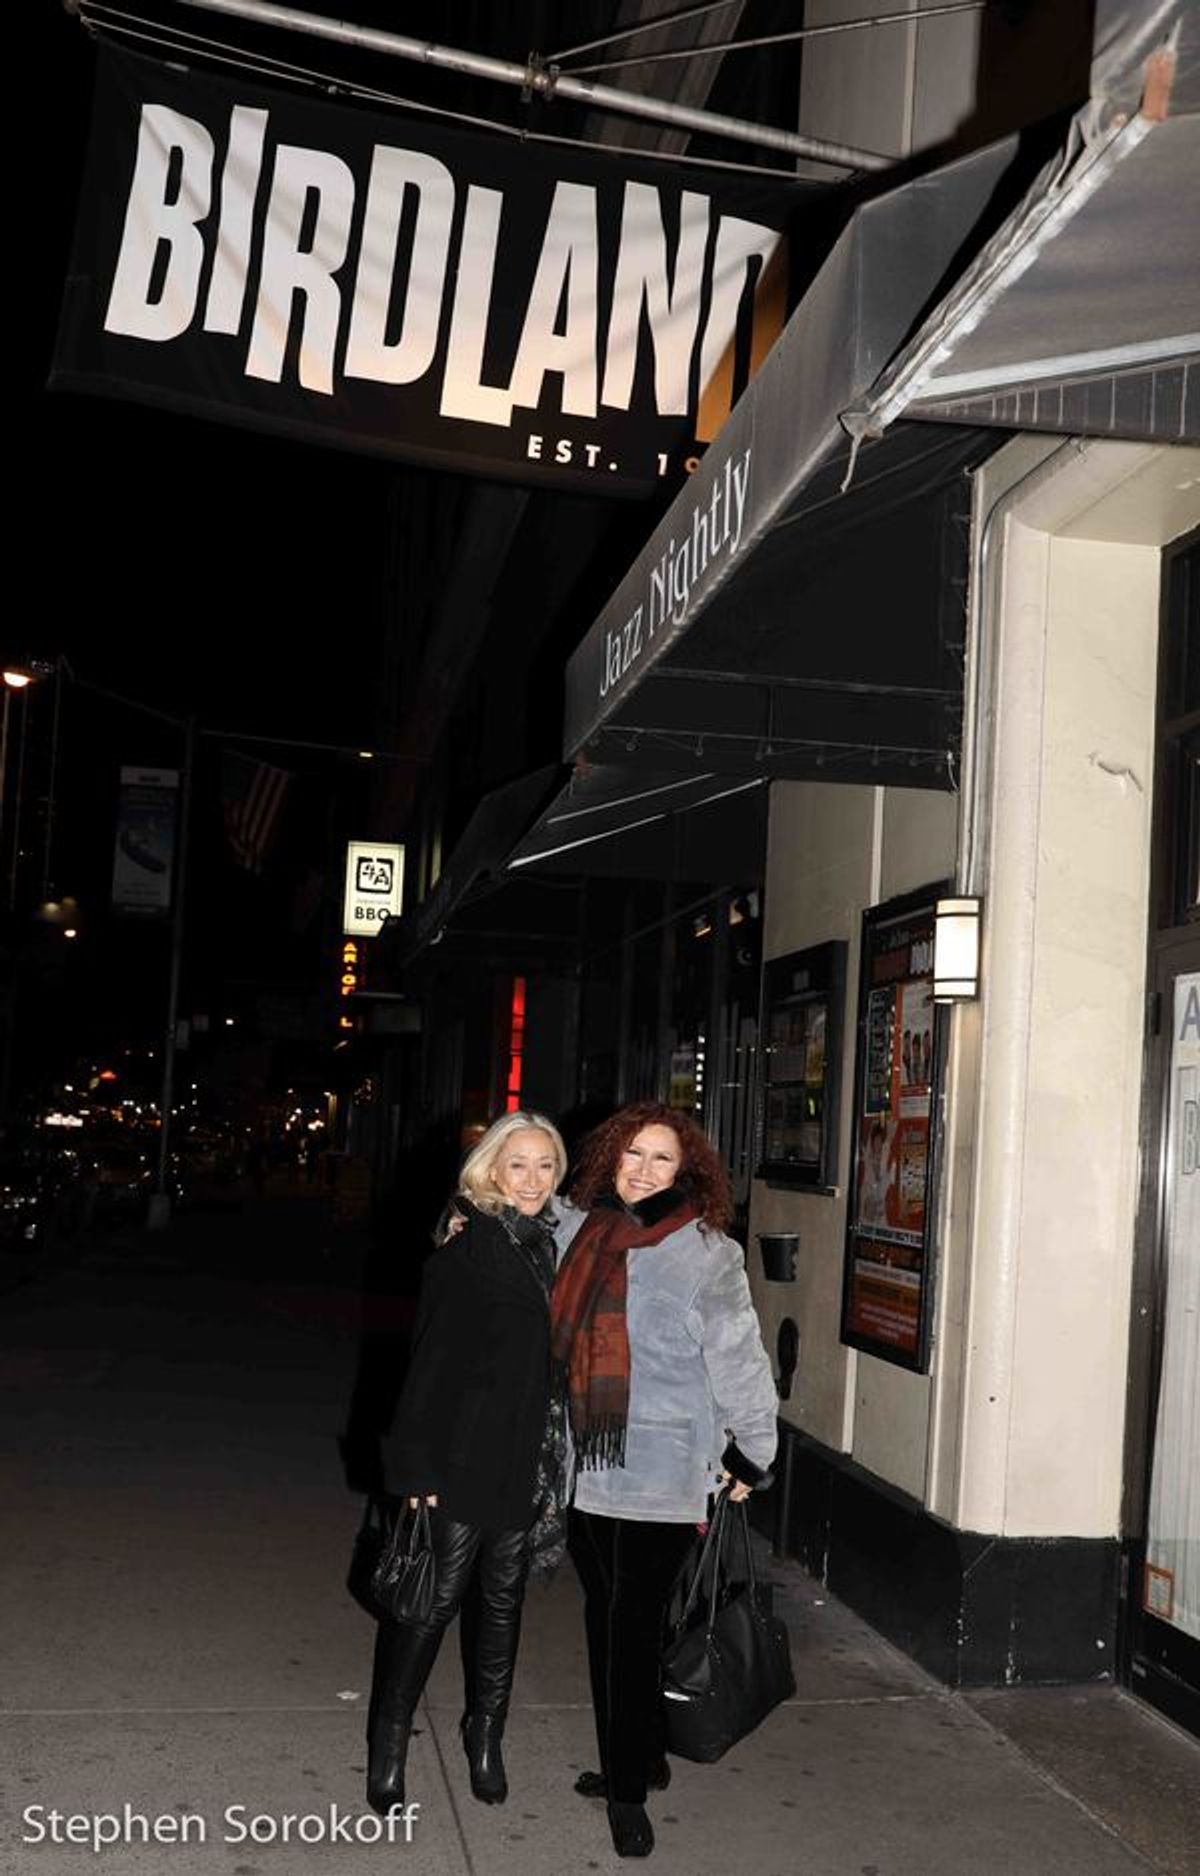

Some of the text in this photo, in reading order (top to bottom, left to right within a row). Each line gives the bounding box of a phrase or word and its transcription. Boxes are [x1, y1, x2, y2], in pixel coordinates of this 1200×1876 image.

[103, 103, 788, 442] BIRDLAND
[527, 434, 618, 471] EST.
[600, 448, 751, 697] Jazz Nightly
